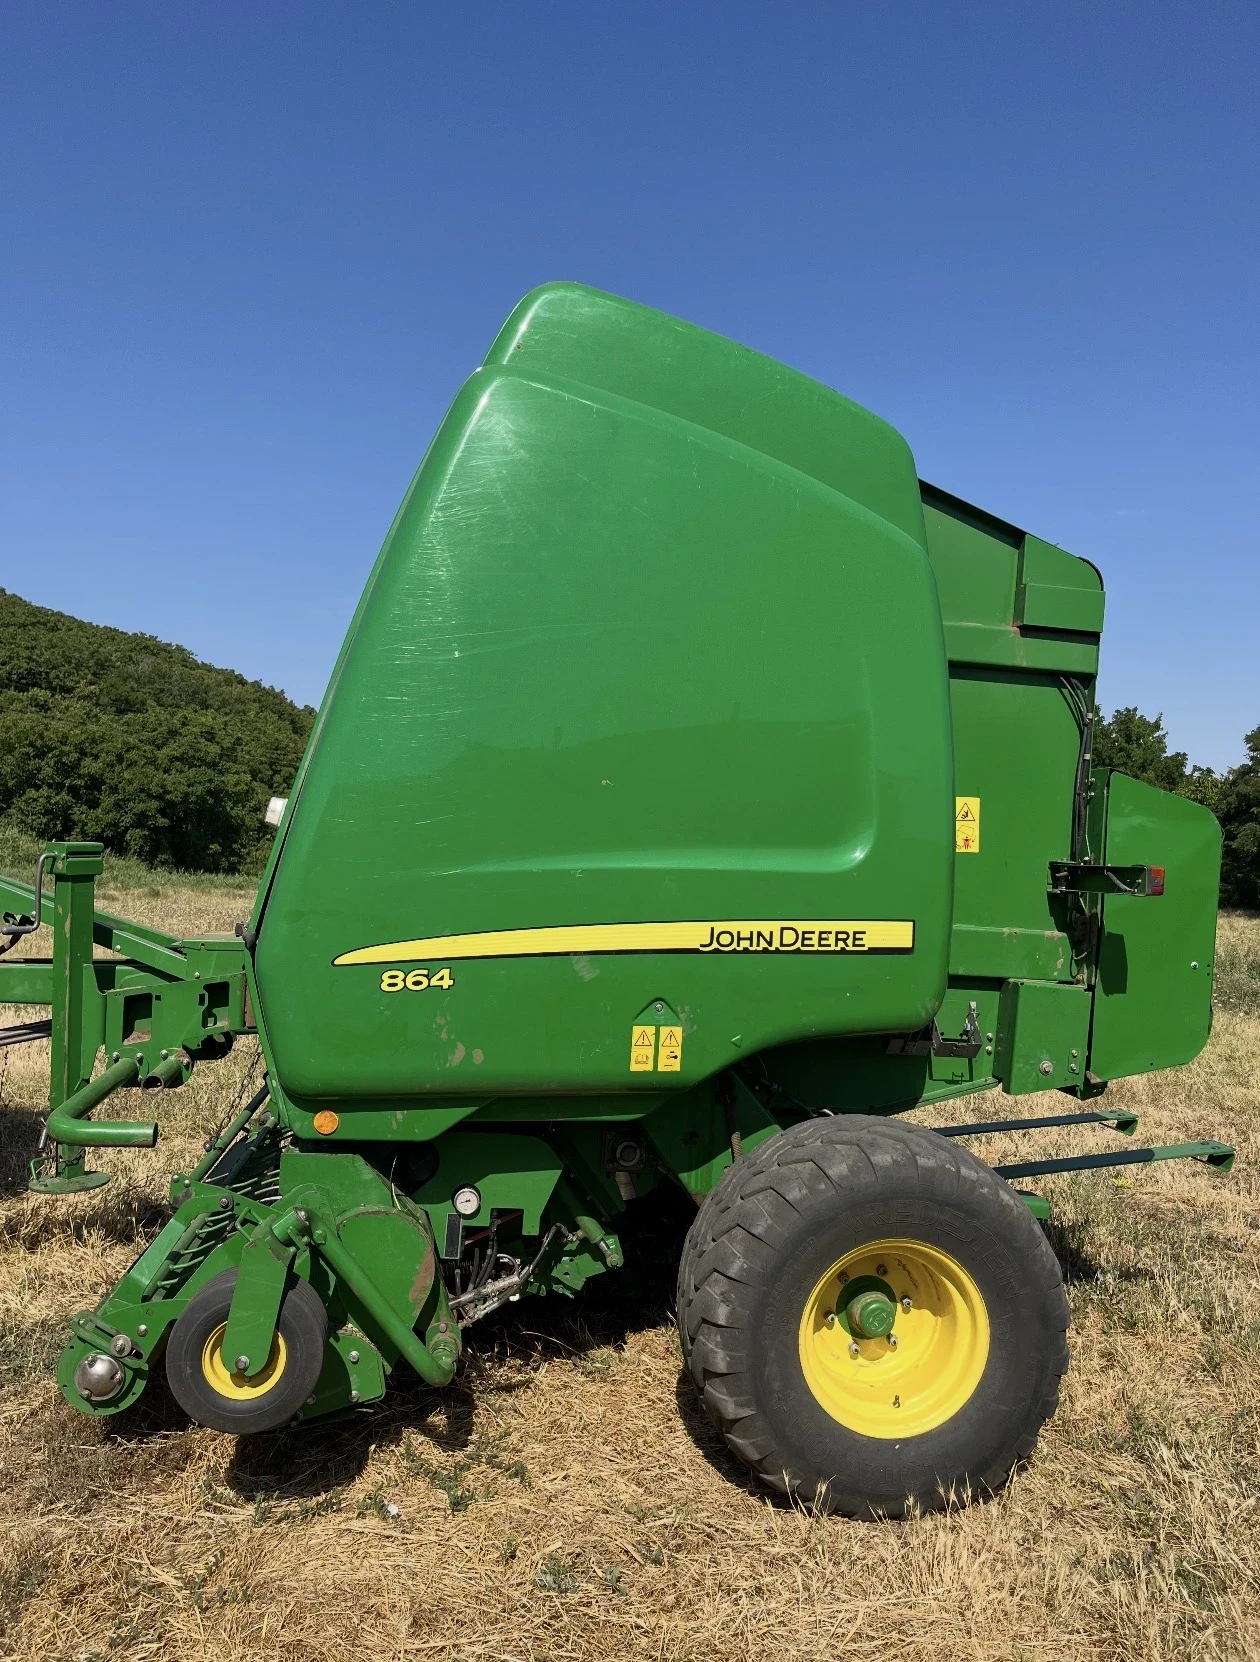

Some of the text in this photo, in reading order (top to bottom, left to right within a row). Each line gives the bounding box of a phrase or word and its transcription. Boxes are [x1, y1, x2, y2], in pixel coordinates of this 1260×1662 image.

[700, 926, 867, 948] JOHN DEERE
[380, 967, 455, 993] 864
